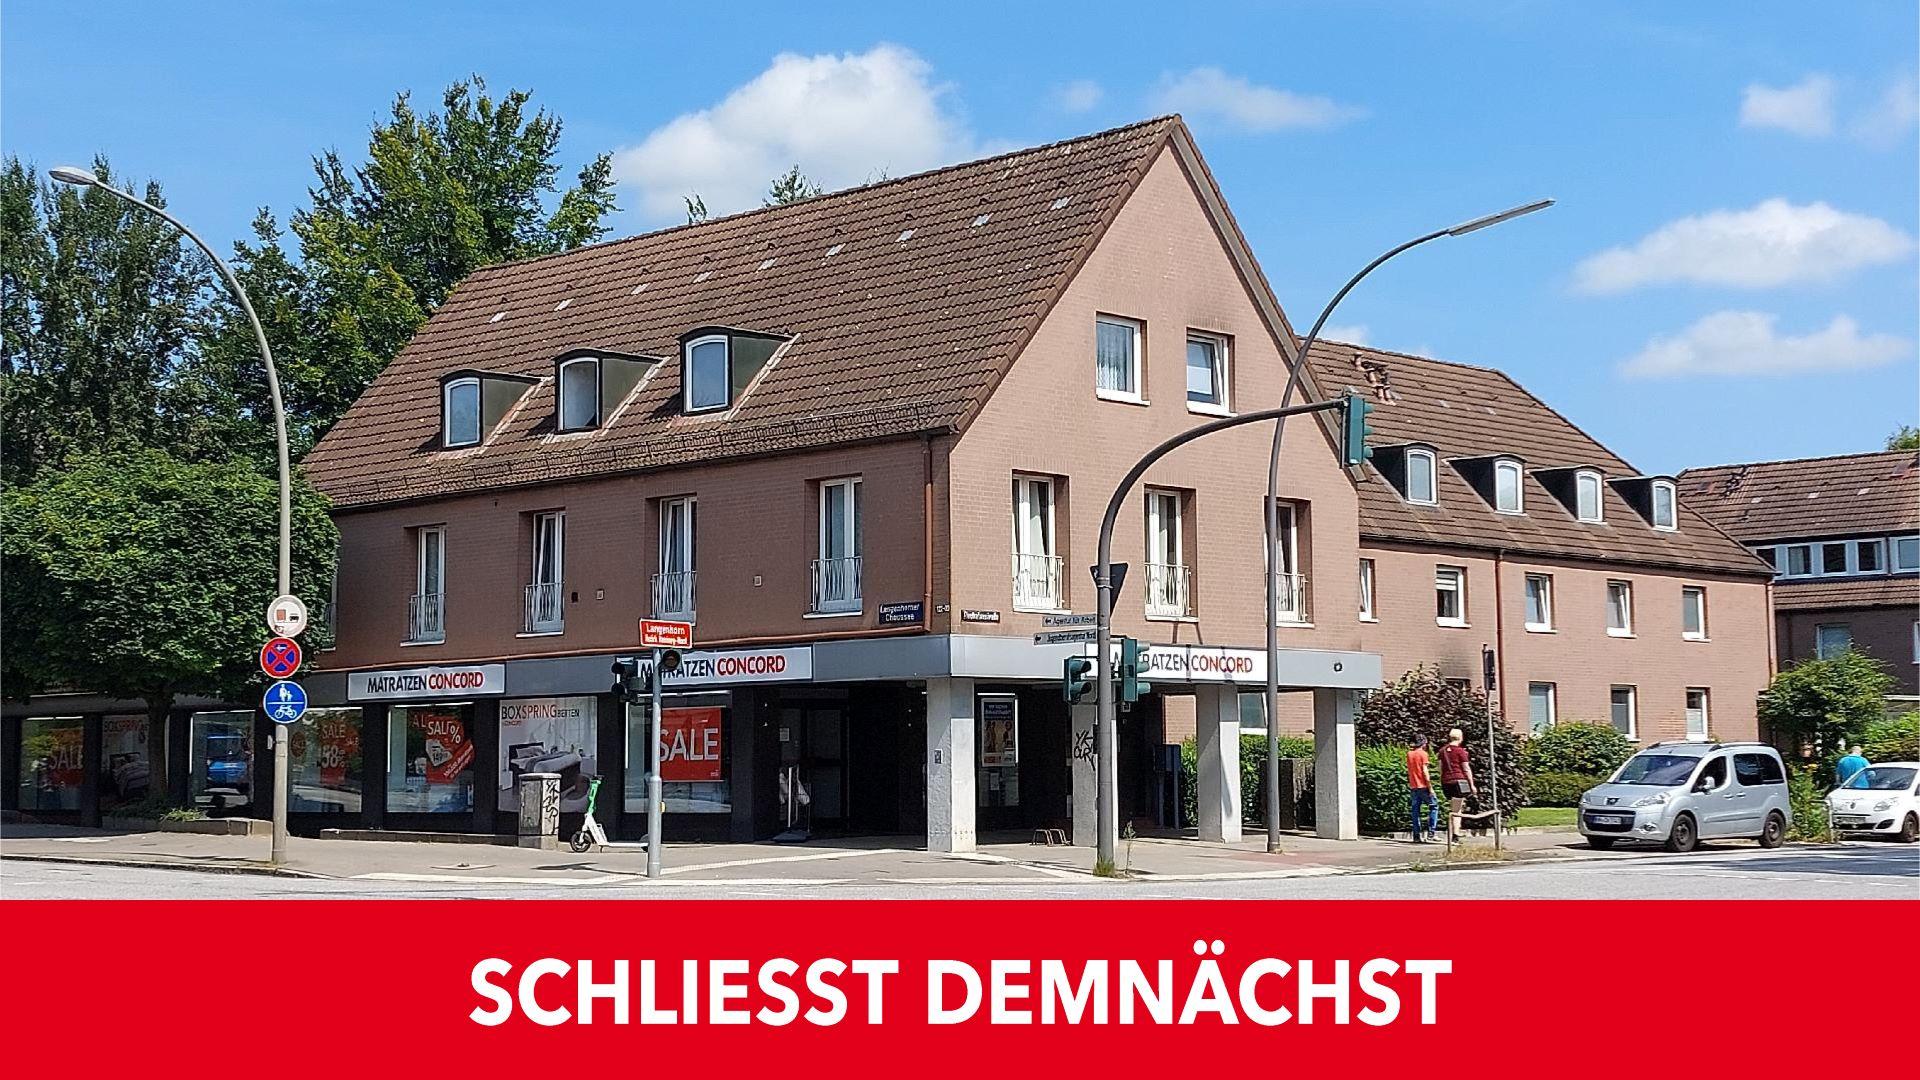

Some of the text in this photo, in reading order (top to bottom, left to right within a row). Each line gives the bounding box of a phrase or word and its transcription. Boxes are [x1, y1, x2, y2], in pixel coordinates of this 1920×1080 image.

[645, 622, 686, 636] Langenhorn
[717, 655, 785, 676] CONCORD
[1191, 655, 1253, 673] CONCORD
[367, 672, 484, 693] MATRATZEN CONCORD
[660, 728, 719, 762] SALE
